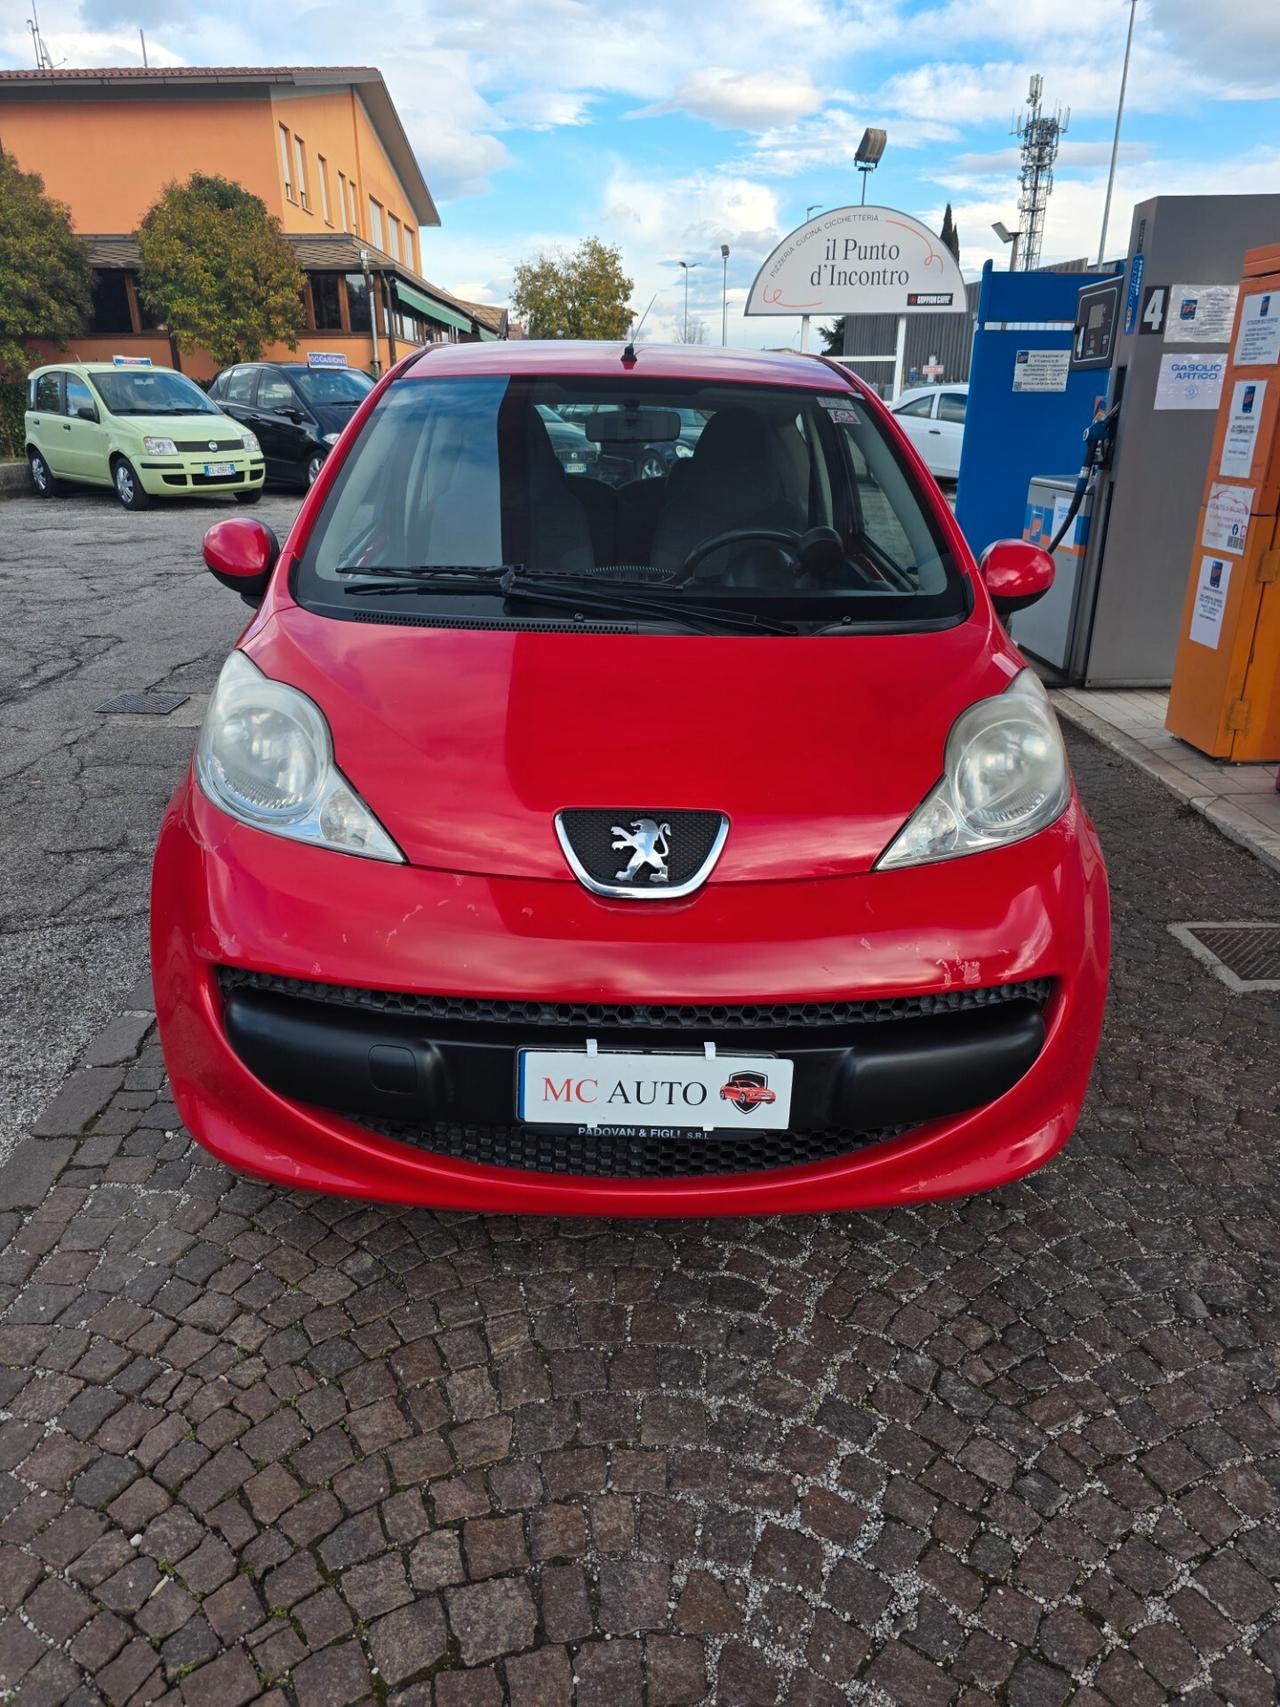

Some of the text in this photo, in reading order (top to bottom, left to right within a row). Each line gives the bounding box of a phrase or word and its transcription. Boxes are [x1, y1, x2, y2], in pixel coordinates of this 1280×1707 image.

[770, 214, 879, 278] PIZZERIA CUCINA CICCHETTERIA
[825, 238, 900, 260] il Punto
[810, 264, 910, 286] d'Incontro
[1143, 289, 1164, 330] 4
[1171, 363, 1222, 371] GASOLIO
[1175, 372, 1218, 380] ARTICO
[543, 1076, 708, 1106] MC AUTO
[578, 1127, 636, 1137] PADOVAN
[638, 1129, 647, 1138] &
